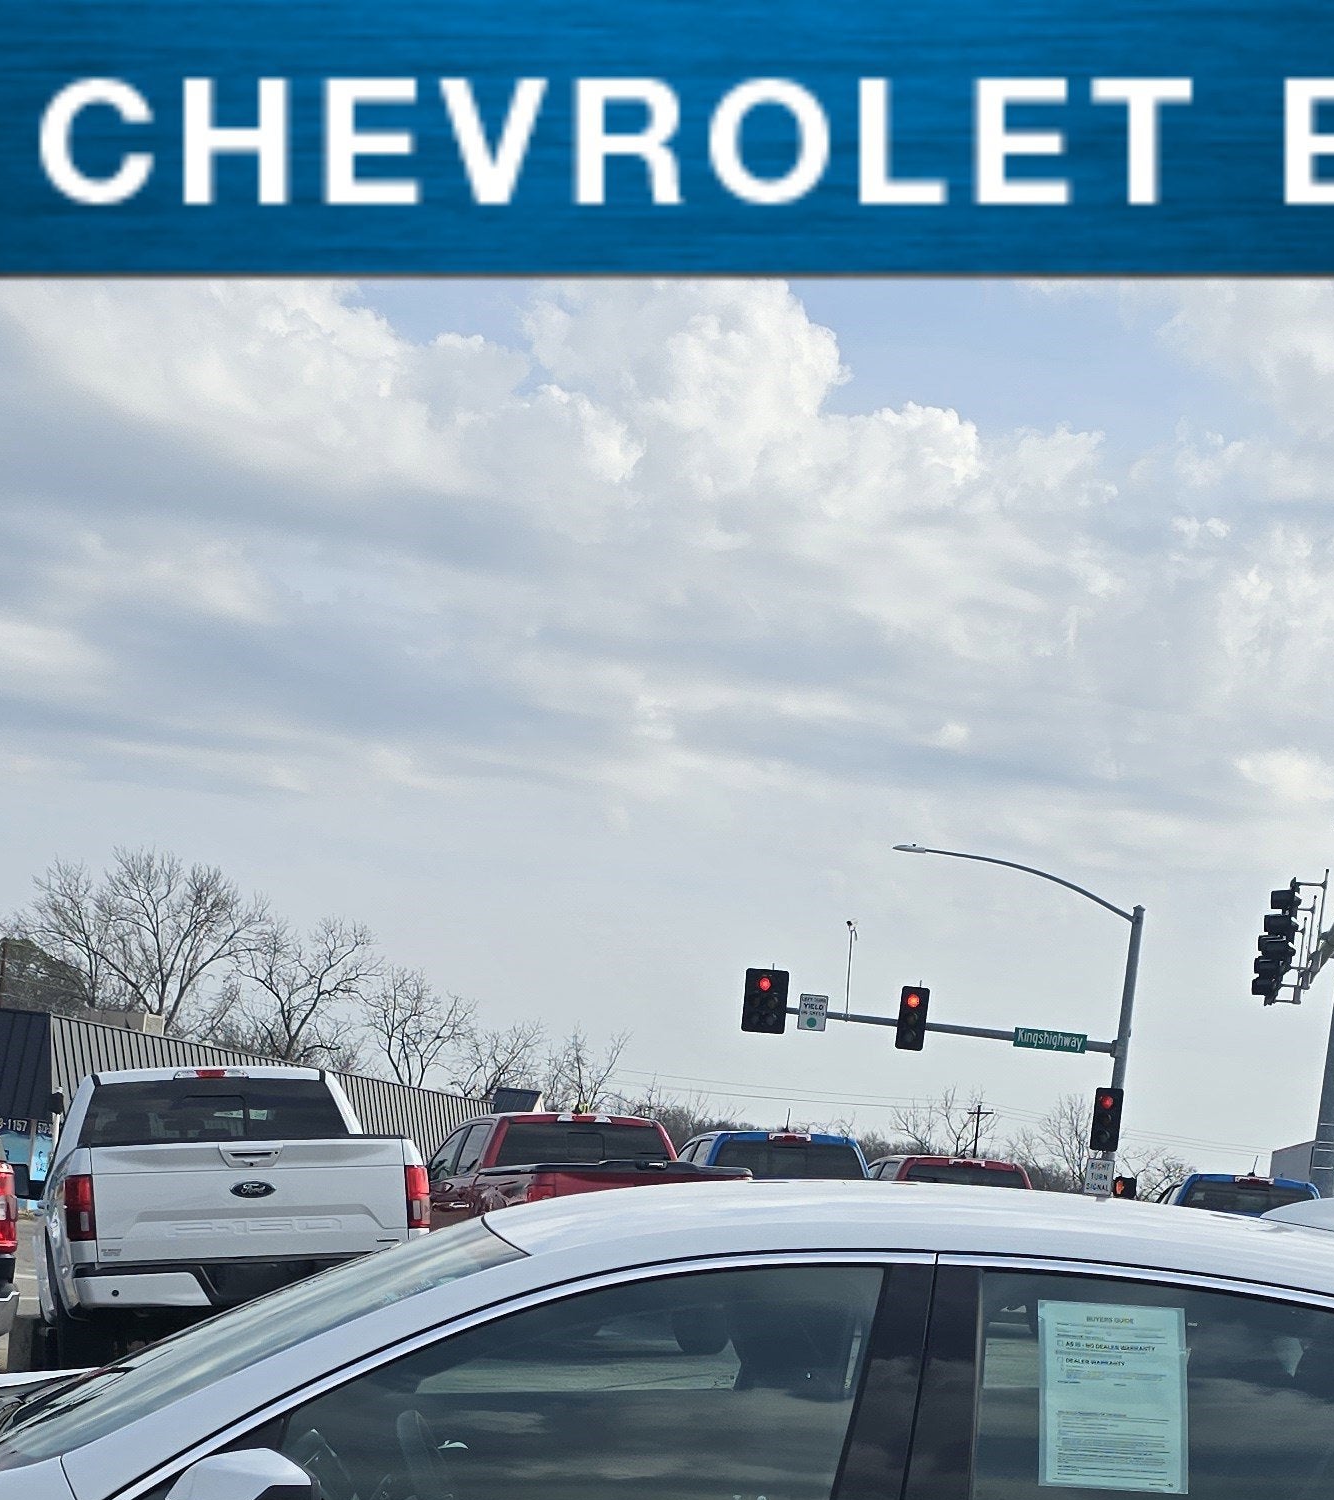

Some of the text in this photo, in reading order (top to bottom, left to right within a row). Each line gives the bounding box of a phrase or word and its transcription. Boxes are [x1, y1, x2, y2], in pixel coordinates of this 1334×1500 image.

[803, 1003, 824, 1011] YIELD
[1017, 1029, 1083, 1051] Kingshighway
[1090, 1162, 1110, 1171] RIGHT
[1091, 1172, 1108, 1180] TURN
[240, 1183, 266, 1194] Ford
[1085, 1182, 1109, 1192] SIGNAL
[1086, 1316, 1135, 1325] BUYERS GUIDE
